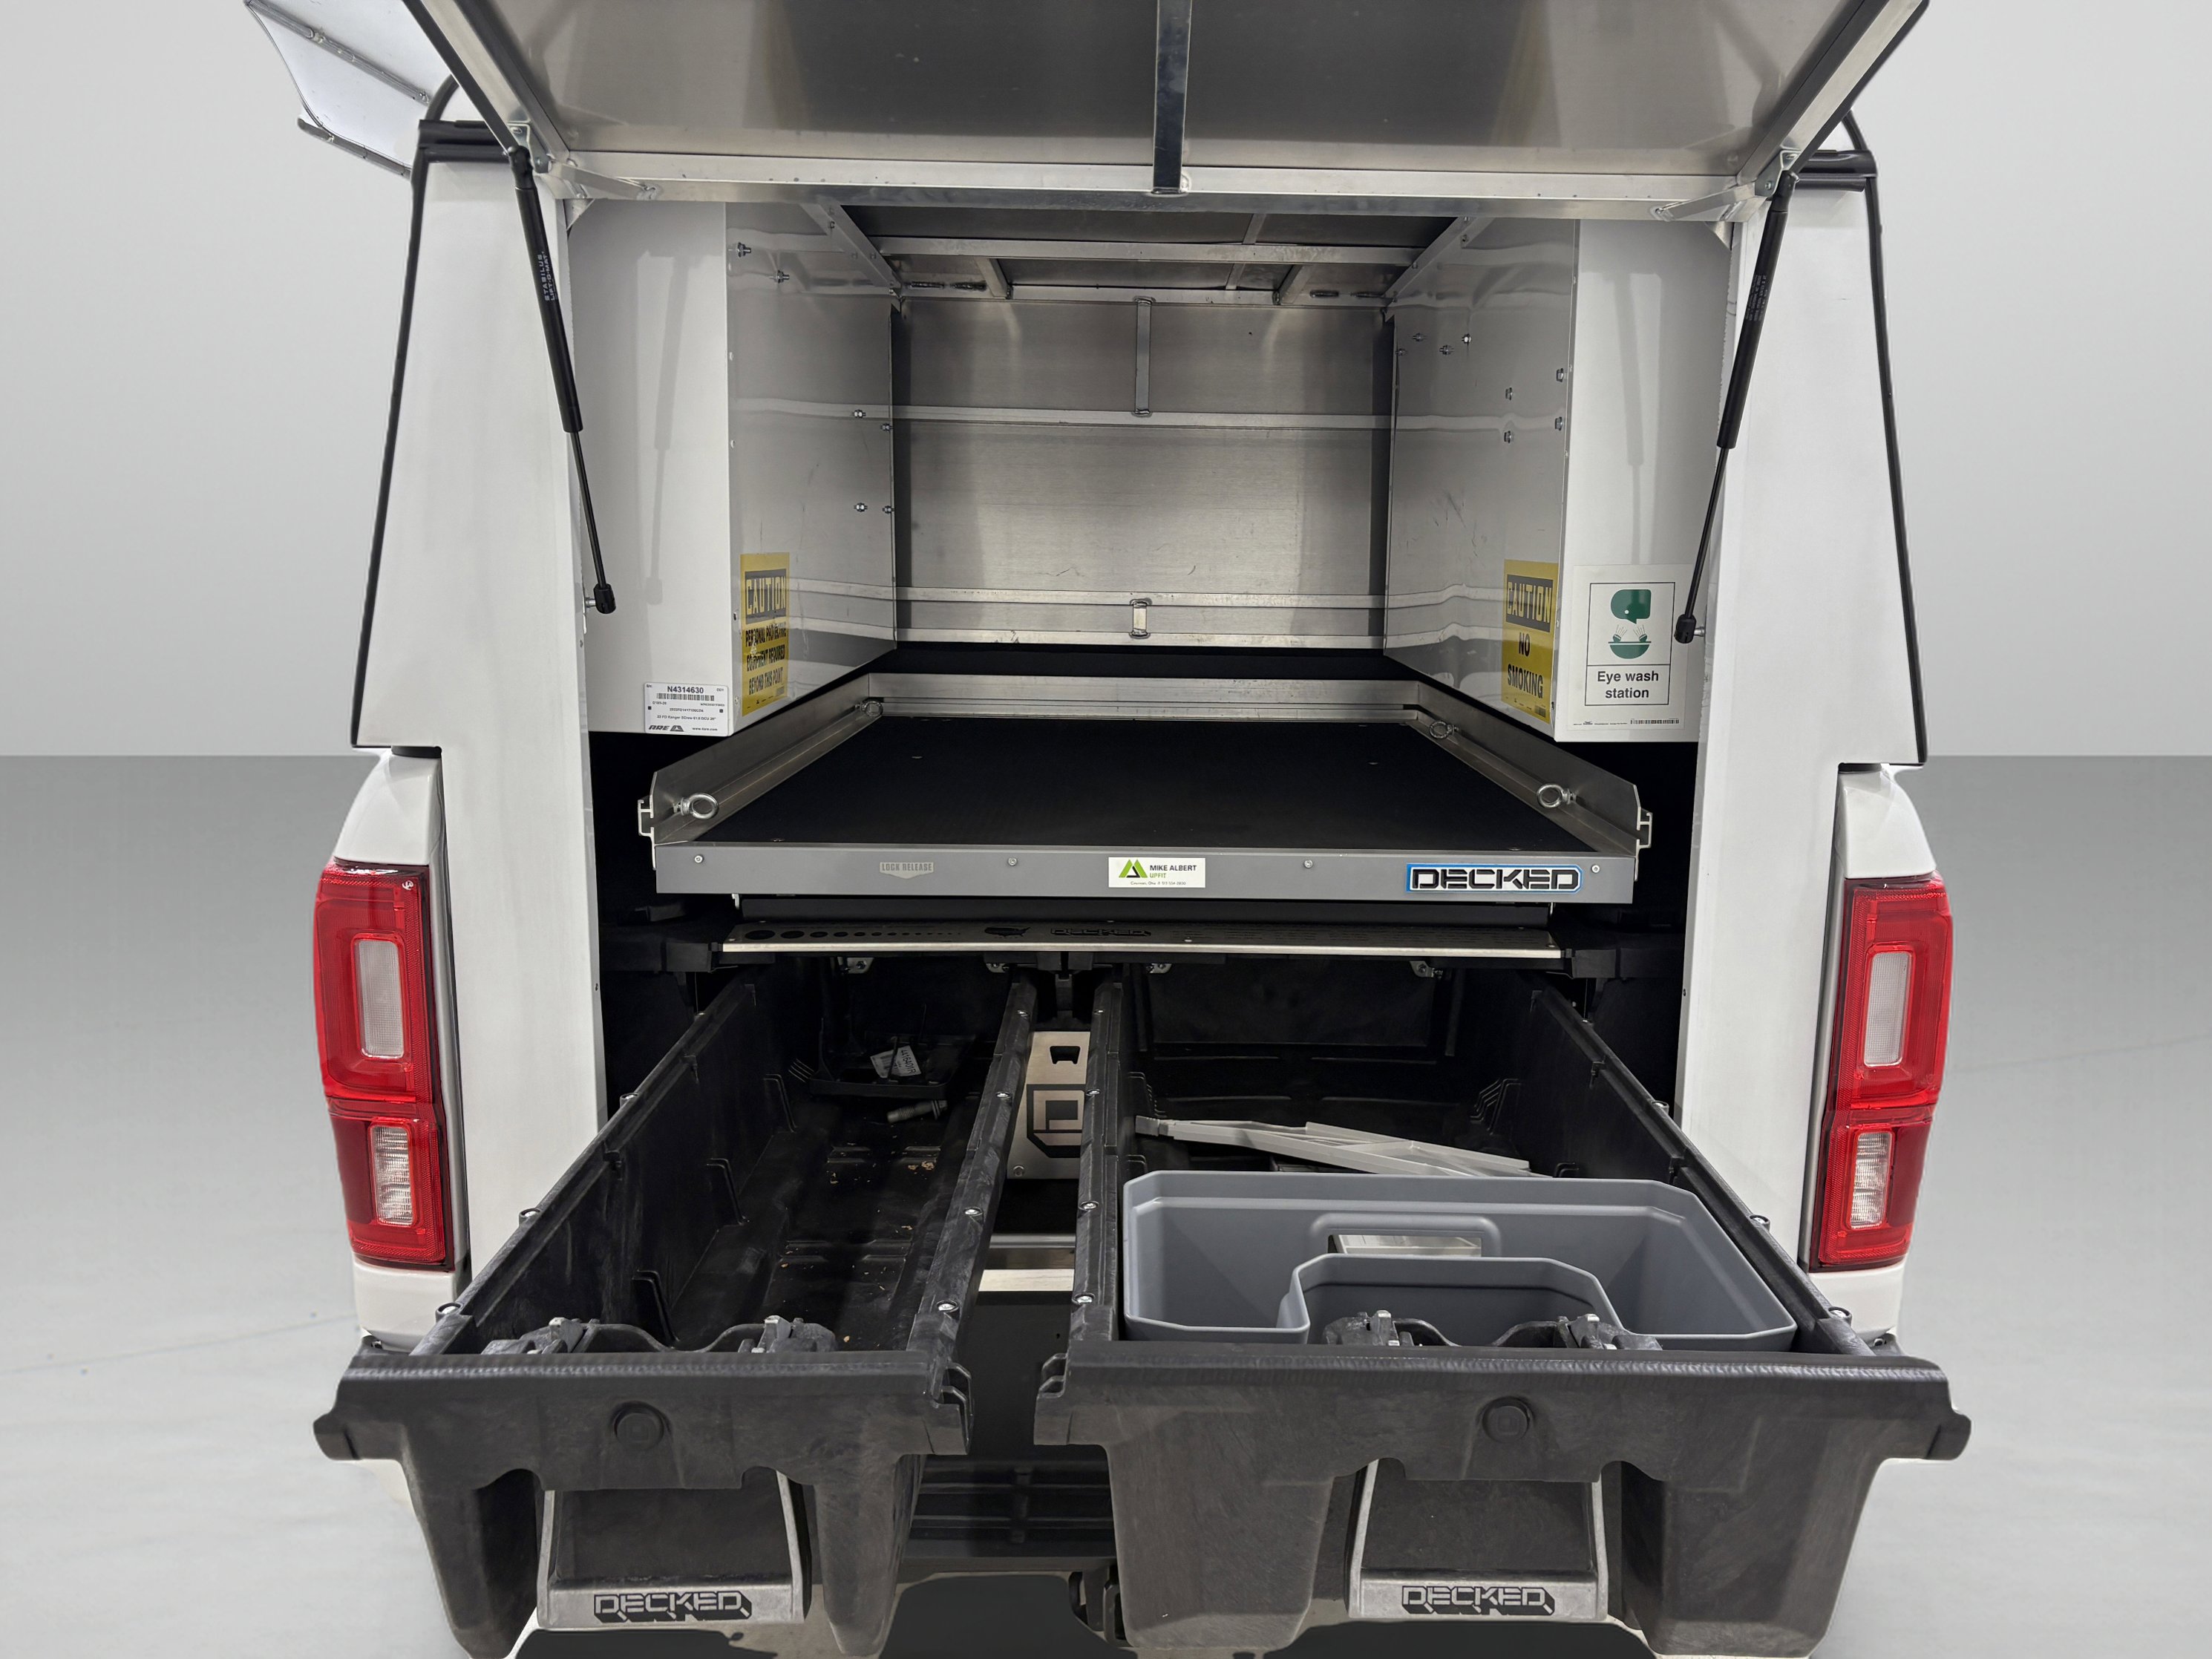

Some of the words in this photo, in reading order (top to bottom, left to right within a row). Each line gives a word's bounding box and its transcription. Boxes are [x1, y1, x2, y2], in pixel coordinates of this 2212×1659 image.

[537, 254, 550, 301] STABILUS
[746, 576, 786, 615] CAUTION
[1507, 581, 1551, 624] CAUTION
[768, 644, 785, 663] REQUIRED
[1519, 632, 1530, 656] NO
[667, 686, 704, 694] N4314630
[749, 674, 764, 696] BEYOND
[764, 671, 773, 688] THIS
[773, 667, 783, 685] POINT
[1508, 664, 1543, 698] SMOKING
[1597, 670, 1621, 684] Eye
[1625, 670, 1659, 682] wash
[1605, 687, 1649, 698] station
[882, 863, 900, 871] LOCK
[902, 863, 932, 871] RELEASE
[1412, 868, 1579, 889] DECKED
[594, 1591, 752, 1623] DECKED
[1401, 1586, 1555, 1616] DECKED
